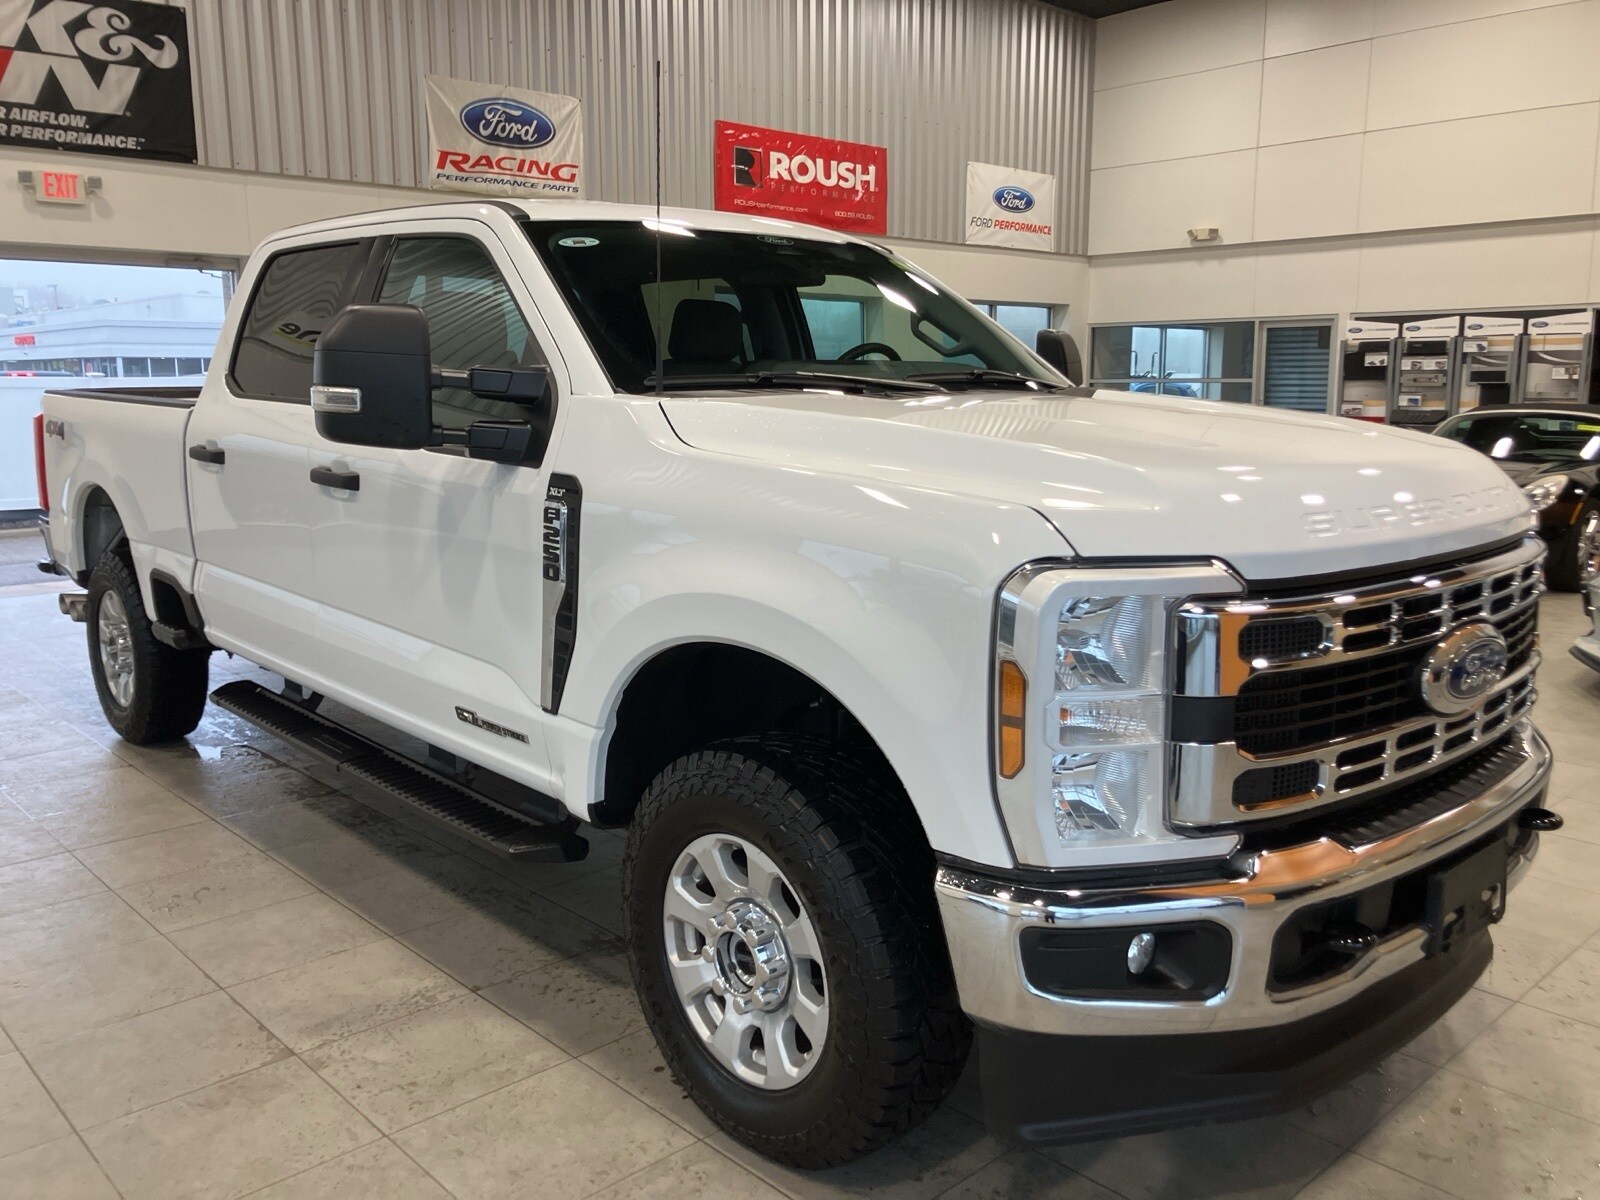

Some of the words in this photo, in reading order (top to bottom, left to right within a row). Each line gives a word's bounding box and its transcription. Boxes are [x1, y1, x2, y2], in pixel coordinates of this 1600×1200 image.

[9, 107, 90, 128] AIRFLOW.
[479, 105, 538, 142] Ford
[436, 150, 579, 183] RACING
[769, 151, 876, 192] ROUSH
[43, 171, 79, 199] EXIT
[436, 173, 538, 189] PERFORMANCE
[542, 183, 579, 193] PARTS
[770, 182, 876, 204] PERFORMANCE
[1001, 189, 1027, 209] Ford
[970, 216, 992, 228] FORD
[994, 219, 1052, 235] PERFORMANCE
[549, 487, 565, 497] XLT
